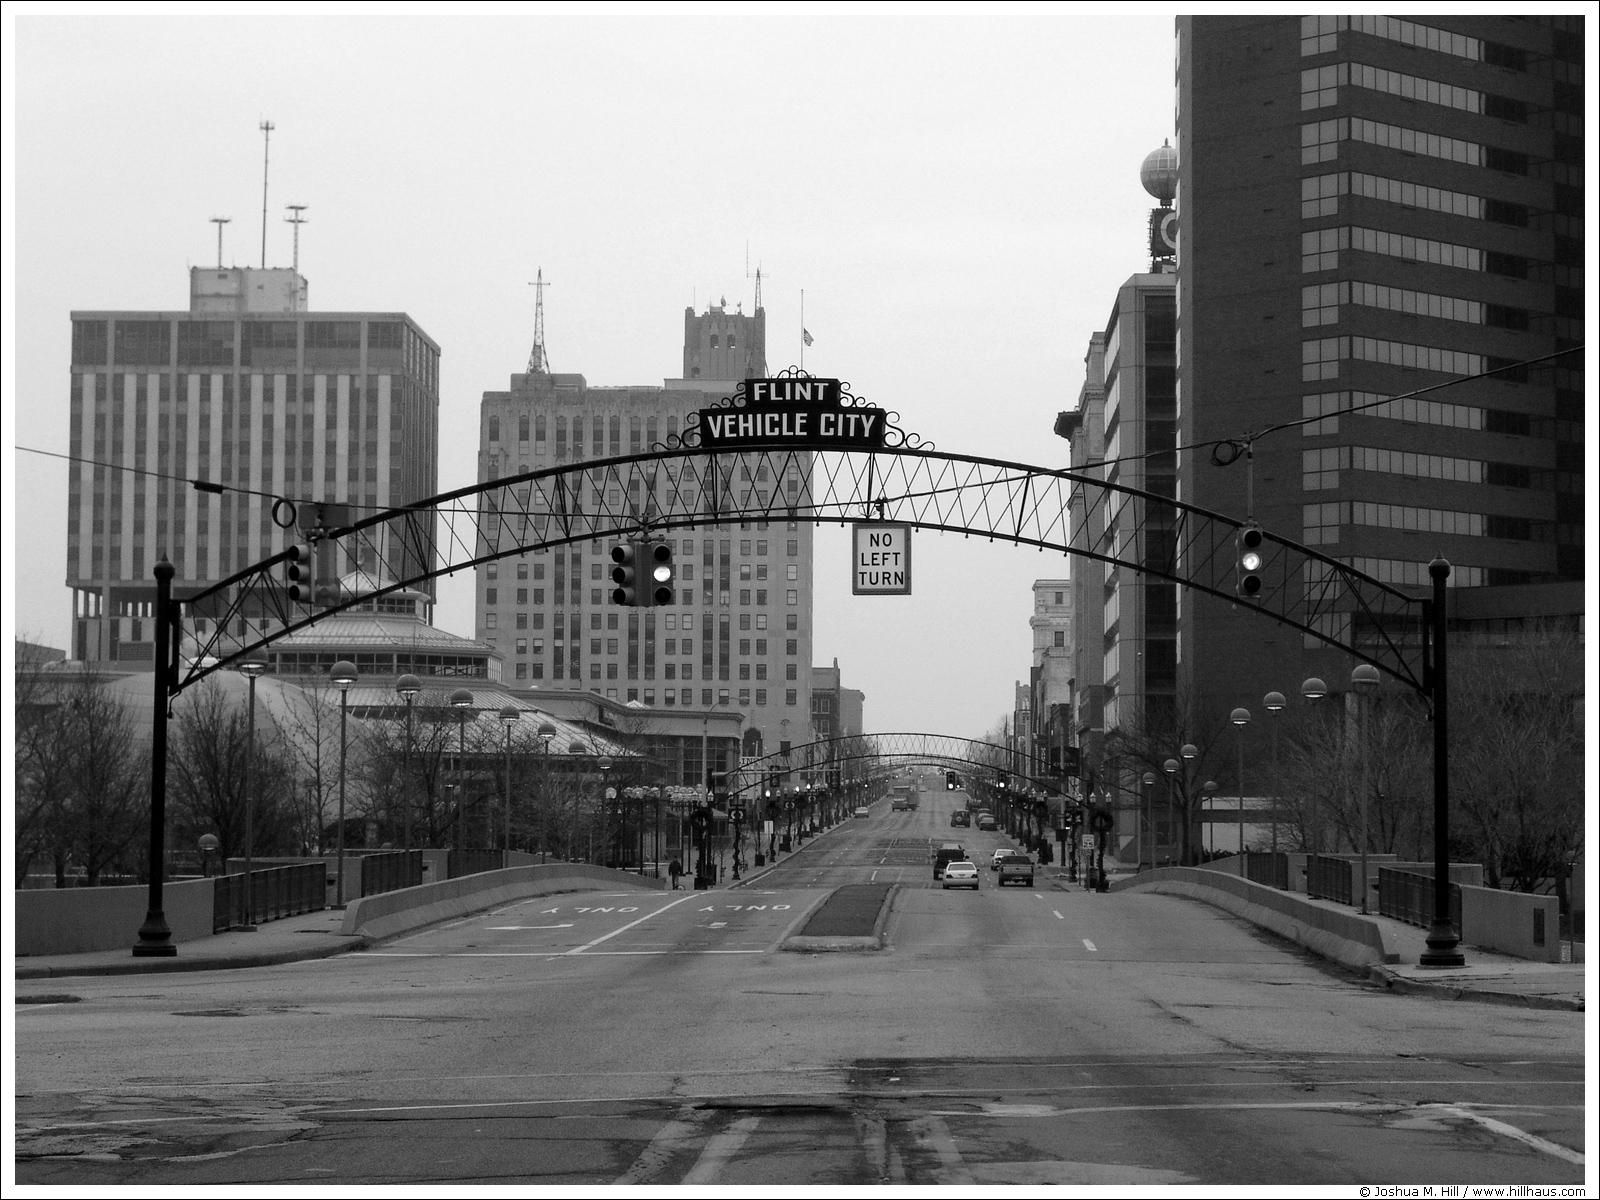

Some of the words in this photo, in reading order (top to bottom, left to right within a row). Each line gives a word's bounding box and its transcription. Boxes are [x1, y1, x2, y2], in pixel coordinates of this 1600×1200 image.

[753, 382, 829, 401] FLINT
[707, 413, 808, 438] VEHICLE
[820, 413, 876, 438] CITY
[869, 533, 892, 547] NO
[861, 552, 901, 566] LEFT
[859, 571, 904, 586] TURN
[540, 906, 639, 914] ONLY
[698, 904, 791, 912] ONLY
